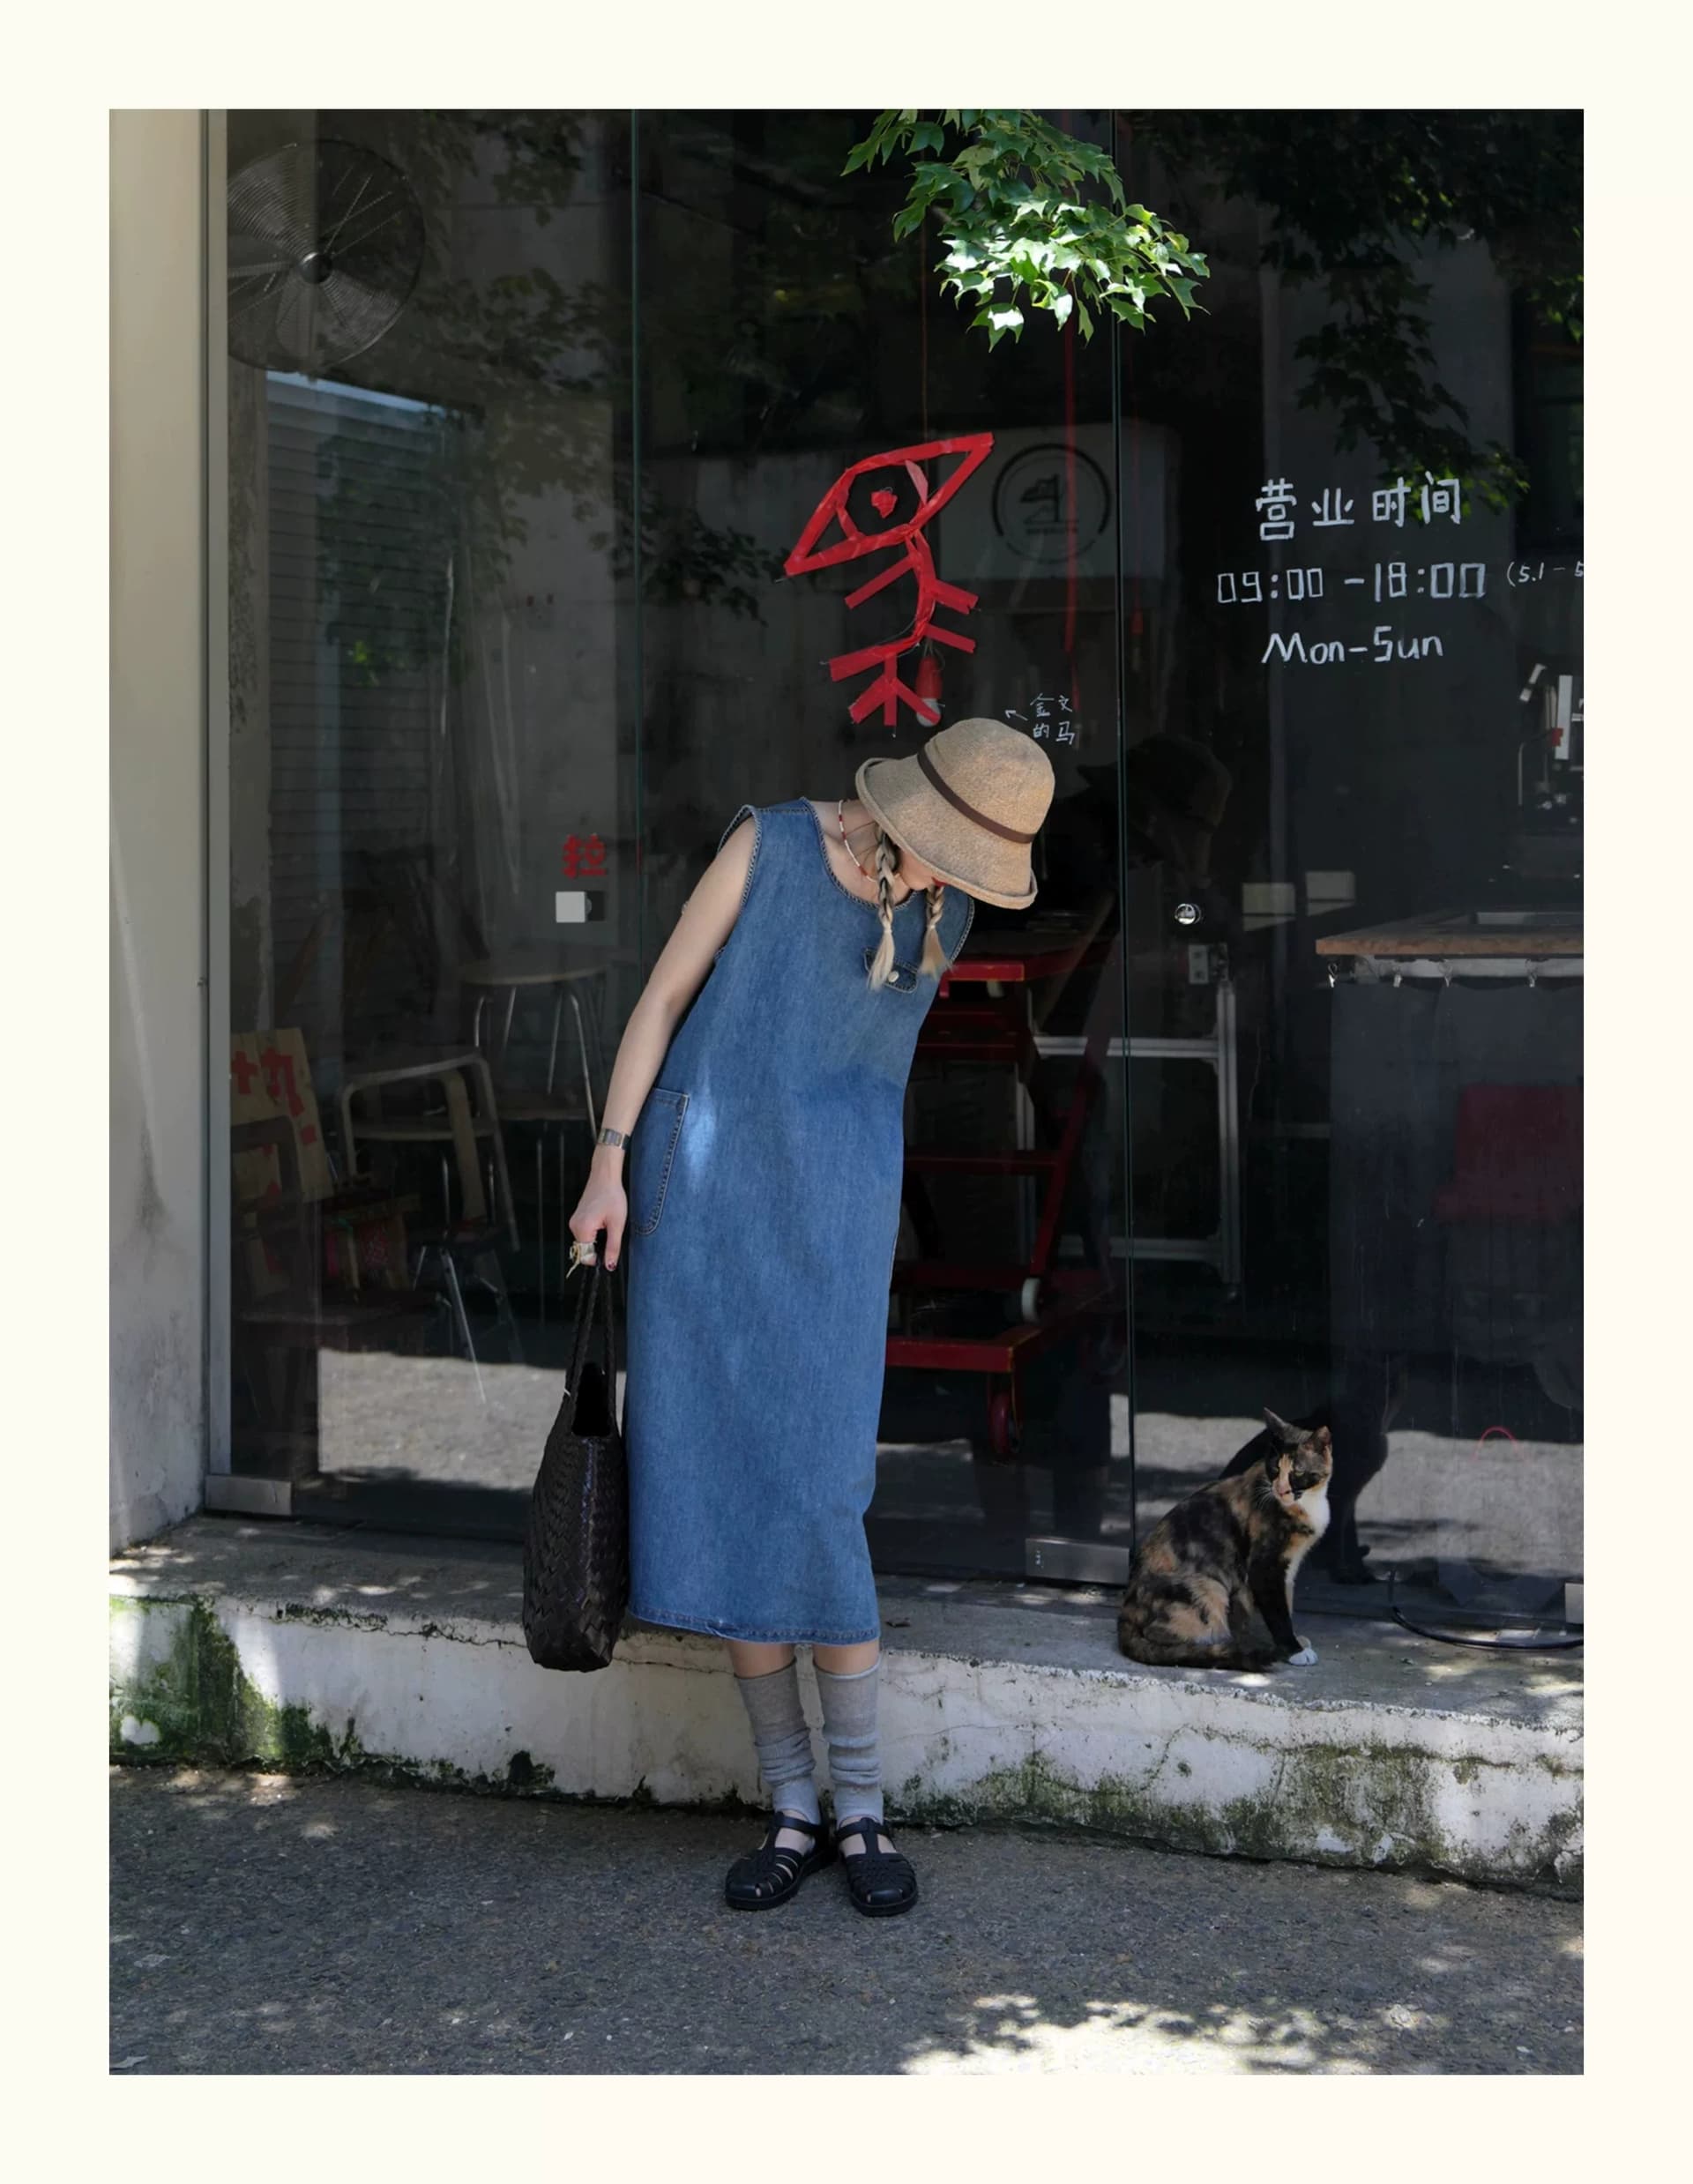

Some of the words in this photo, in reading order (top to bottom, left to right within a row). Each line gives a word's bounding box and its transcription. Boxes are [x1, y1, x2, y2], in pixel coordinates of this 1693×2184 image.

[1256, 471, 1461, 540] 营业时间
[1261, 625, 1444, 665] Mon-Sun
[1029, 693, 1073, 718] 金文
[1033, 721, 1075, 745] 的马
